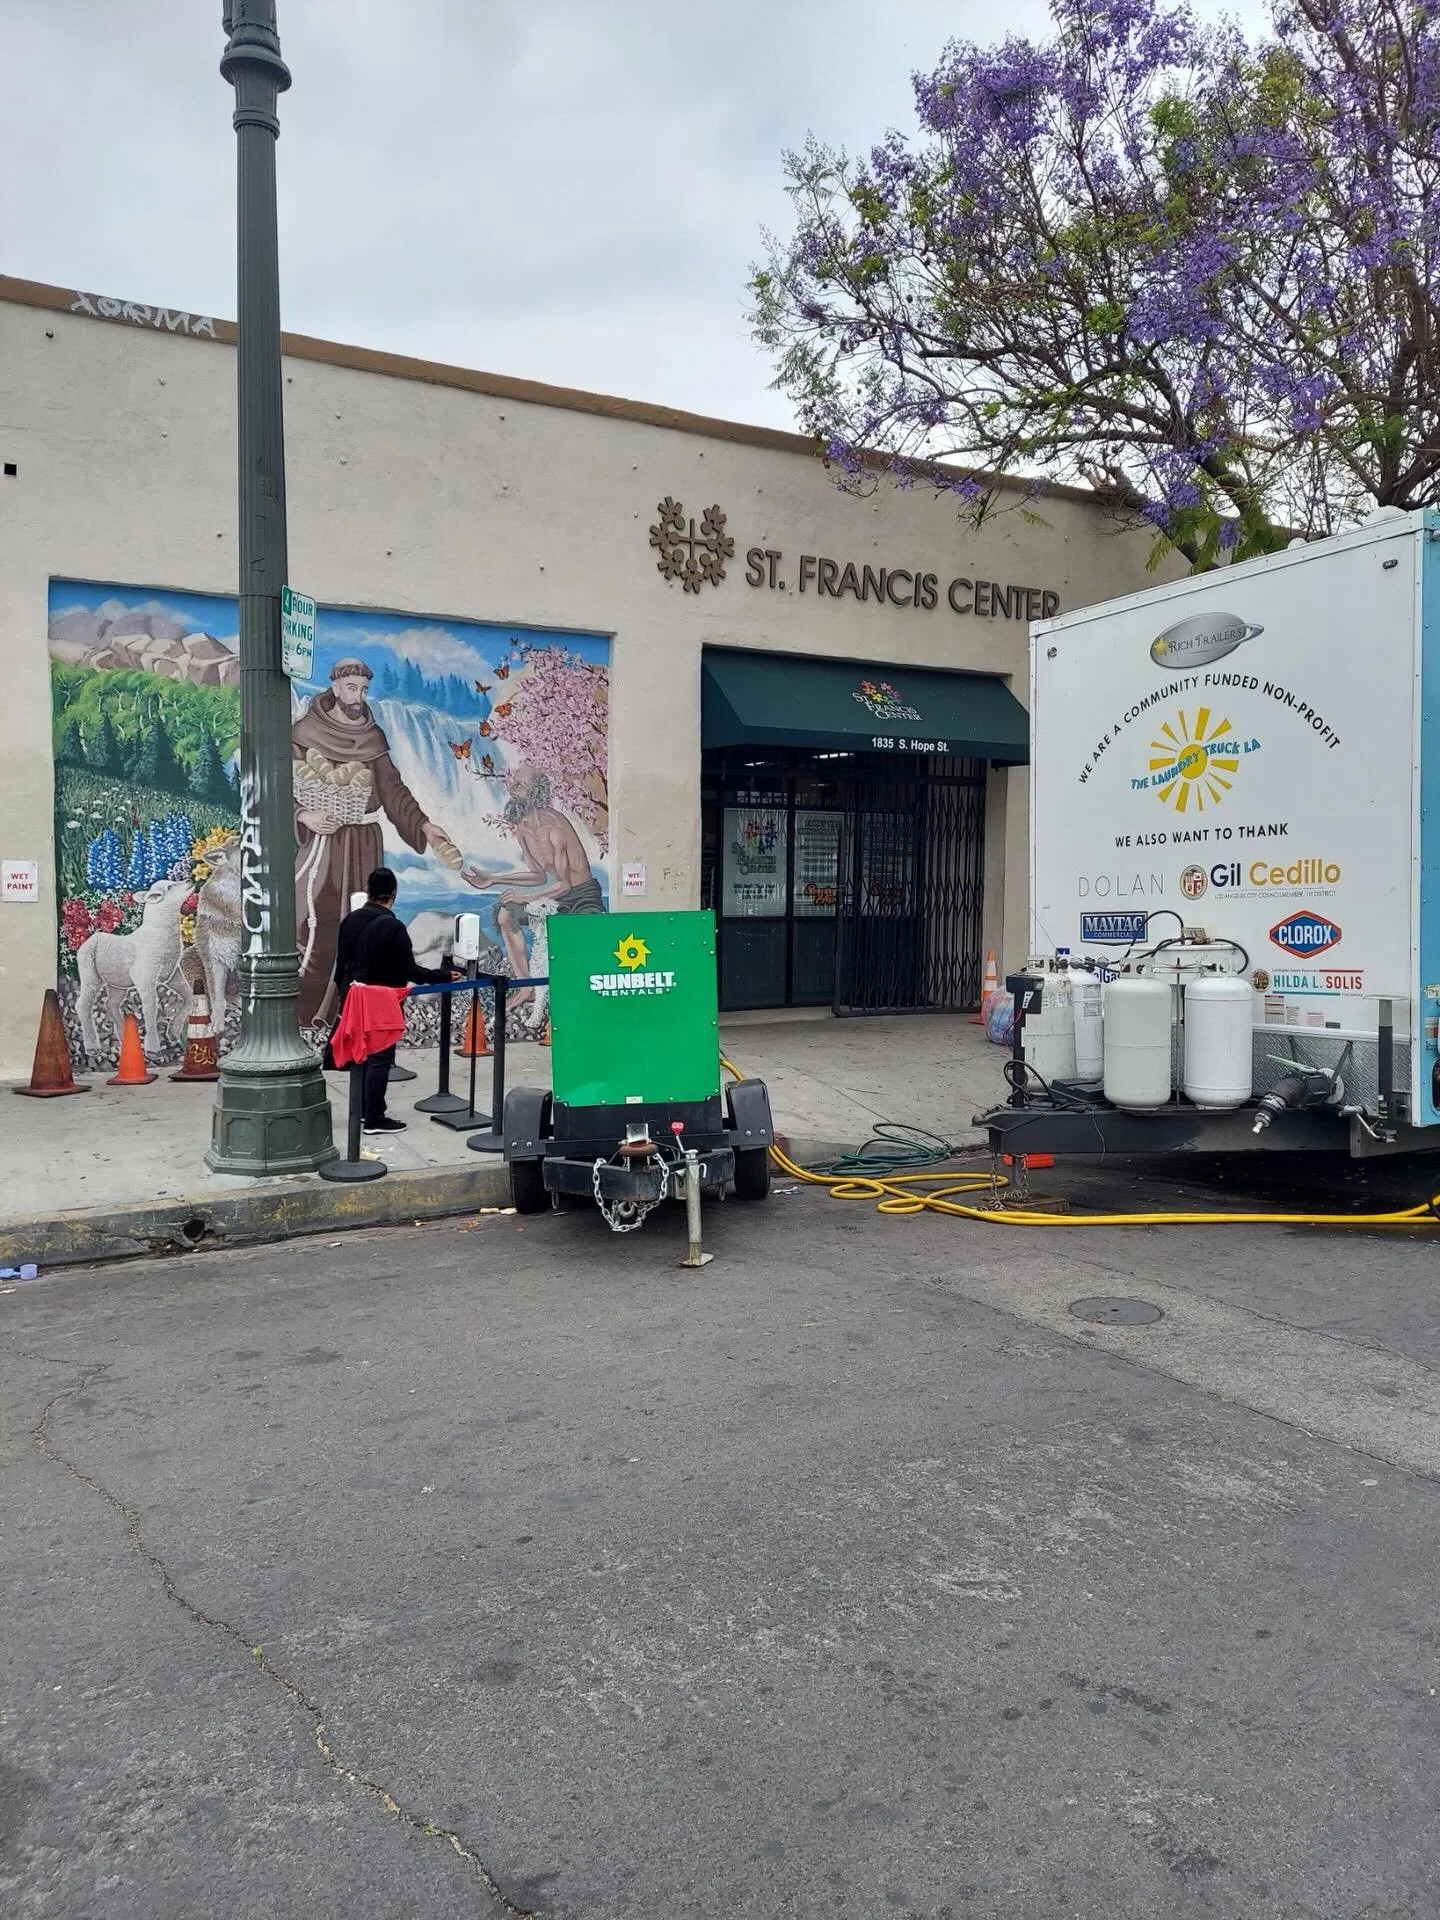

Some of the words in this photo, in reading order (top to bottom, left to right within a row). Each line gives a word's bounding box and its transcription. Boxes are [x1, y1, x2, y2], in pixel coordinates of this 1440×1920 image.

[745, 547, 785, 590] ST.
[799, 555, 939, 611] FRANCIS
[948, 577, 1061, 621] CENTER
[1078, 763, 1093, 784] WE
[1092, 734, 1112, 762] ARE
[1113, 724, 1122, 735] A
[1123, 676, 1199, 724] COMMUNITY
[1204, 673, 1259, 690] FUNDED
[1262, 681, 1341, 749] NON-PROFIT
[871, 737, 895, 749] 1835
[898, 739, 908, 750] S.
[910, 740, 935, 753] Hope
[936, 741, 950, 752] St.
[1130, 777, 1150, 790] THE
[1151, 750, 1201, 787] LAUNDRY
[1201, 741, 1241, 757] TRUCK
[1243, 738, 1261, 754] LA
[1115, 835, 1132, 848] WE
[1135, 833, 1168, 847] ALSO
[1172, 829, 1210, 844] WANT
[1214, 827, 1233, 841] TO
[1238, 822, 1289, 839] THANK
[1210, 862, 1241, 888] Gil
[1248, 858, 1342, 887] Cedillo
[1078, 873, 1165, 898] DOLAN
[1084, 916, 1144, 932] MAYTAG
[1278, 924, 1333, 945] CLOROX
[589, 971, 675, 991] SUNBELT
[601, 987, 664, 997] RENTALS
[1273, 975, 1309, 988] HILDA
[1312, 977, 1323, 989] L.
[1326, 976, 1363, 990] SOLIS
